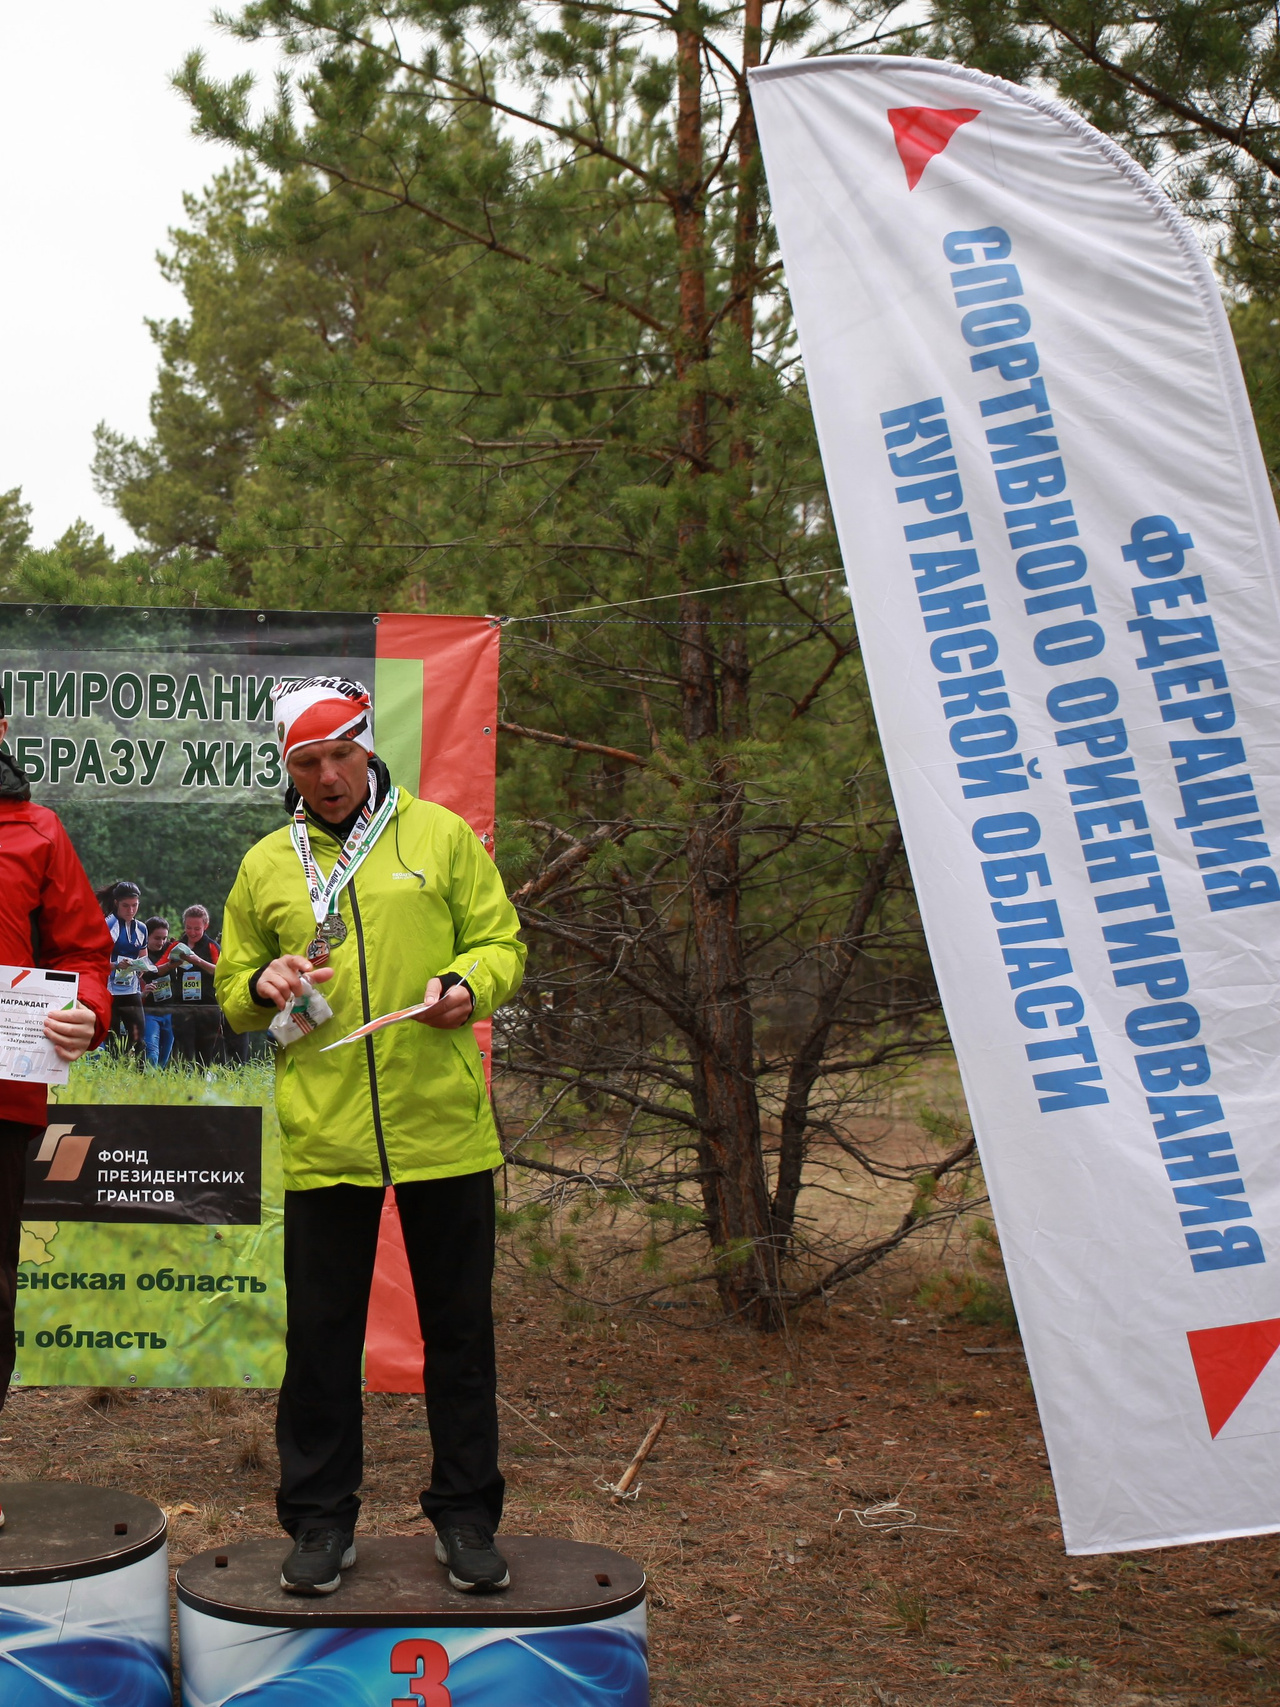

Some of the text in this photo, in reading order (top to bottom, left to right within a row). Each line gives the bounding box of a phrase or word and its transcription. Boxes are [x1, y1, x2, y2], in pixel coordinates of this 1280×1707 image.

[1121, 515, 1280, 912] ФЕДЕРАЦИЯ
[879, 397, 1110, 1113] КУРГАНСКОЙ ОБЛАСТИ
[942, 226, 1267, 1273] СПОРТИВНОГО ОРИЕНТИРОВАНИЯ
[0, 998, 49, 1008] НАГРАЖДАЕТ
[98, 1150, 149, 1164] ФОНД
[97, 1169, 245, 1184] ПРЕЗИДЕНТСКИХ
[97, 1189, 175, 1202] ГРАНТОВ
[136, 1267, 267, 1293] область
[35, 1323, 167, 1350] область
[389, 1637, 452, 1707] 3
